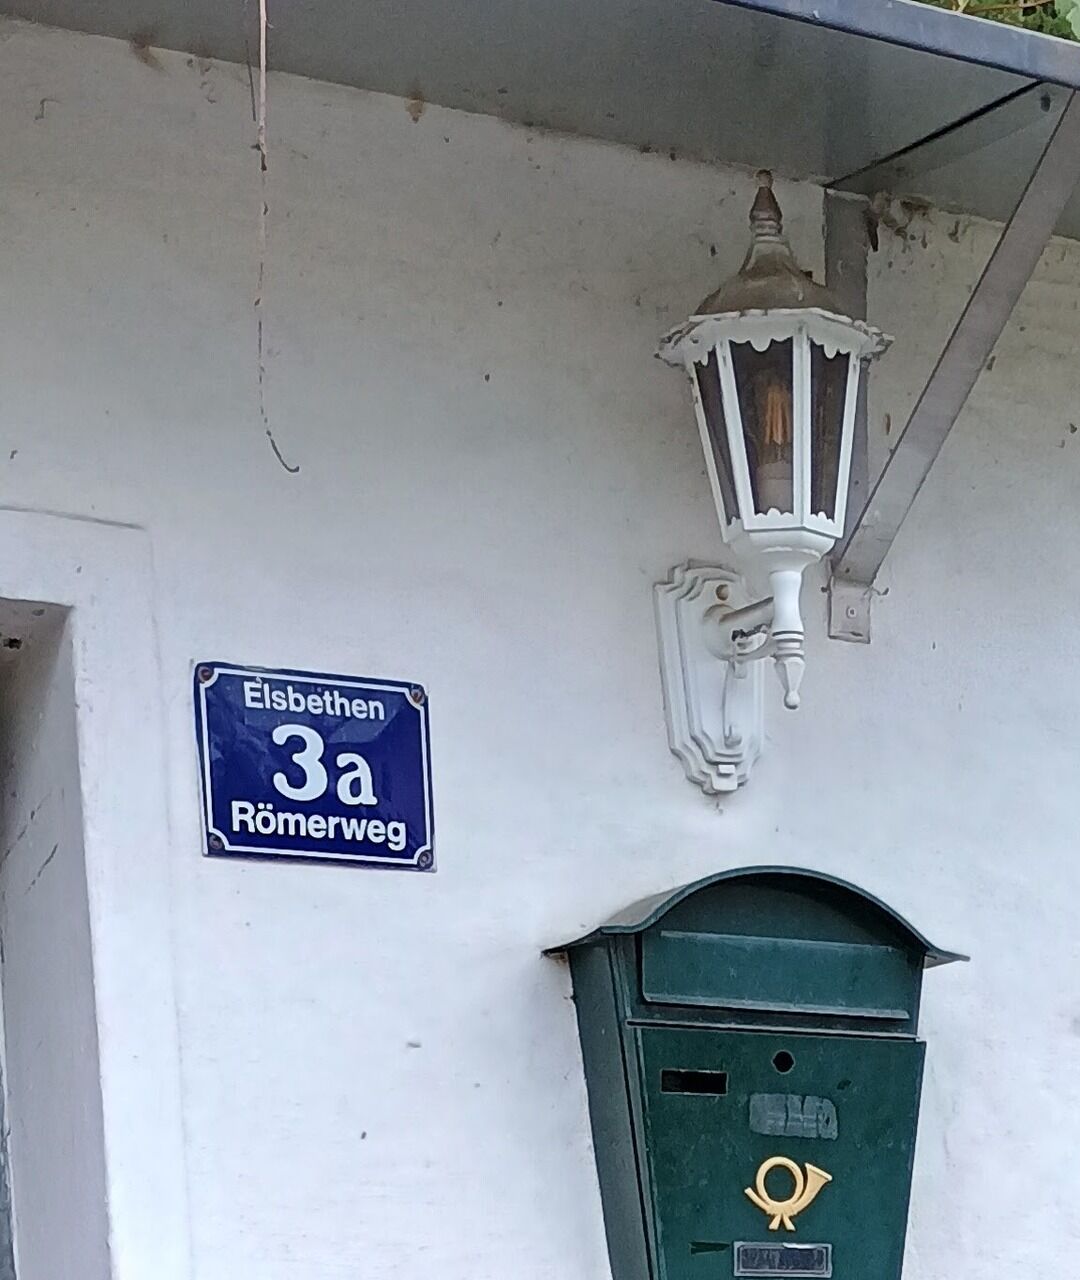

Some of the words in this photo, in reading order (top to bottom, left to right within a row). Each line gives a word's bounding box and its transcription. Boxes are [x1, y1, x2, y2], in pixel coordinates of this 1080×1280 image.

[243, 681, 385, 720] Elsbethen
[271, 723, 378, 805] 3a
[231, 800, 407, 851] Römerweg
